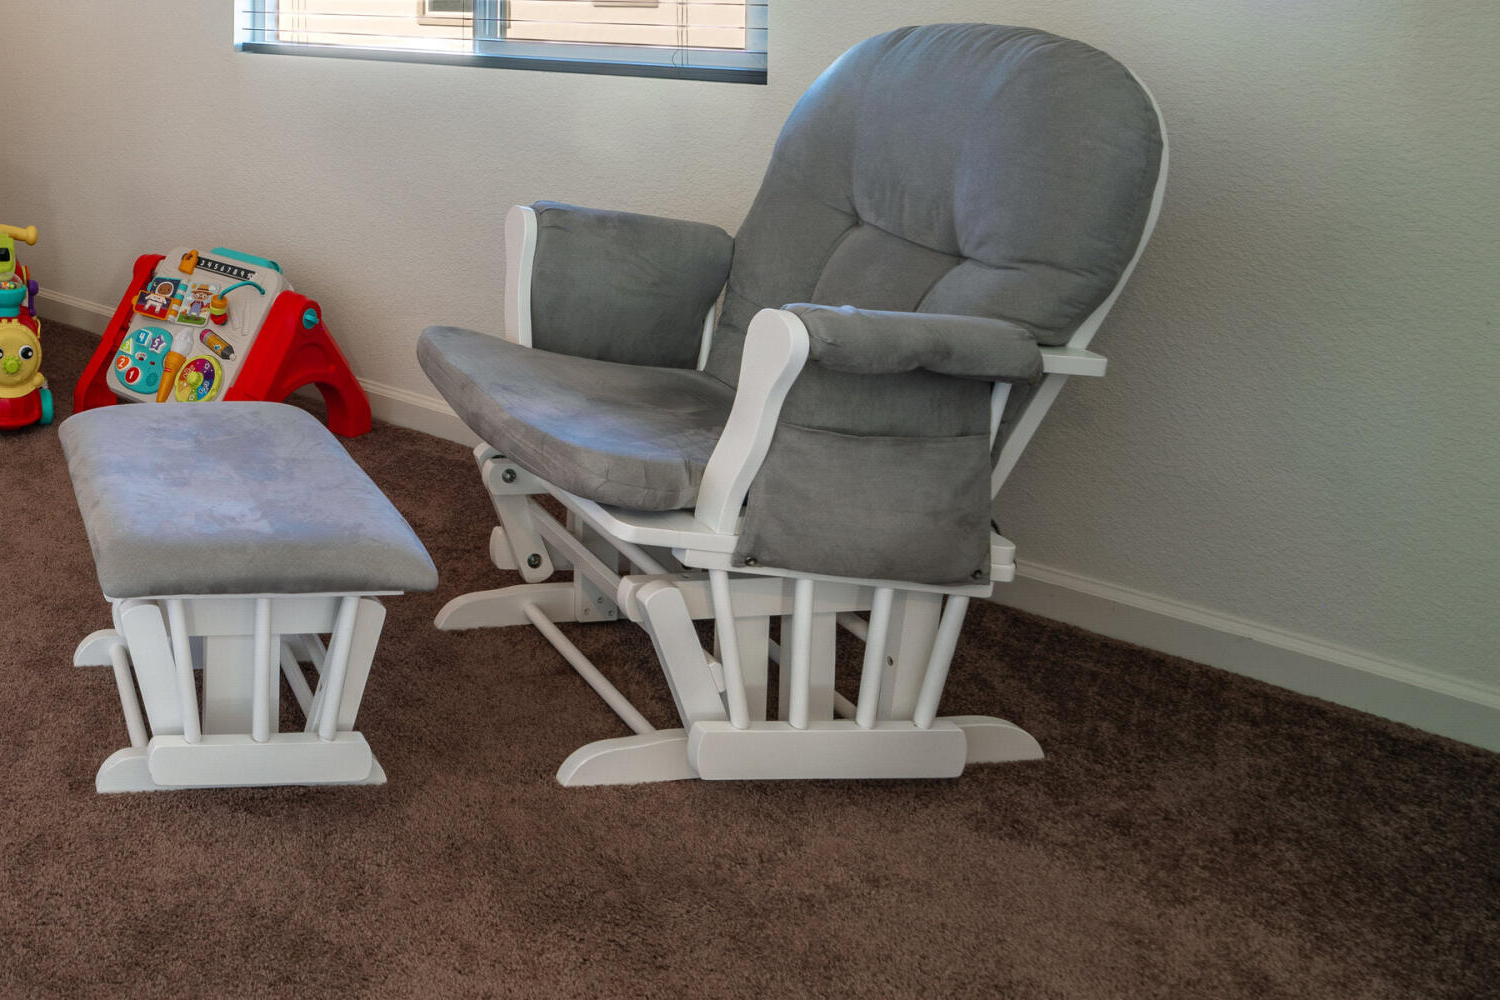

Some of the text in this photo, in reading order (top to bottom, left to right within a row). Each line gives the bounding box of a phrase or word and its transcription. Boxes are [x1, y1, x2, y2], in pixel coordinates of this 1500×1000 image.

[138, 331, 146, 342] 4
[154, 338, 161, 349] 5
[118, 358, 125, 368] 2
